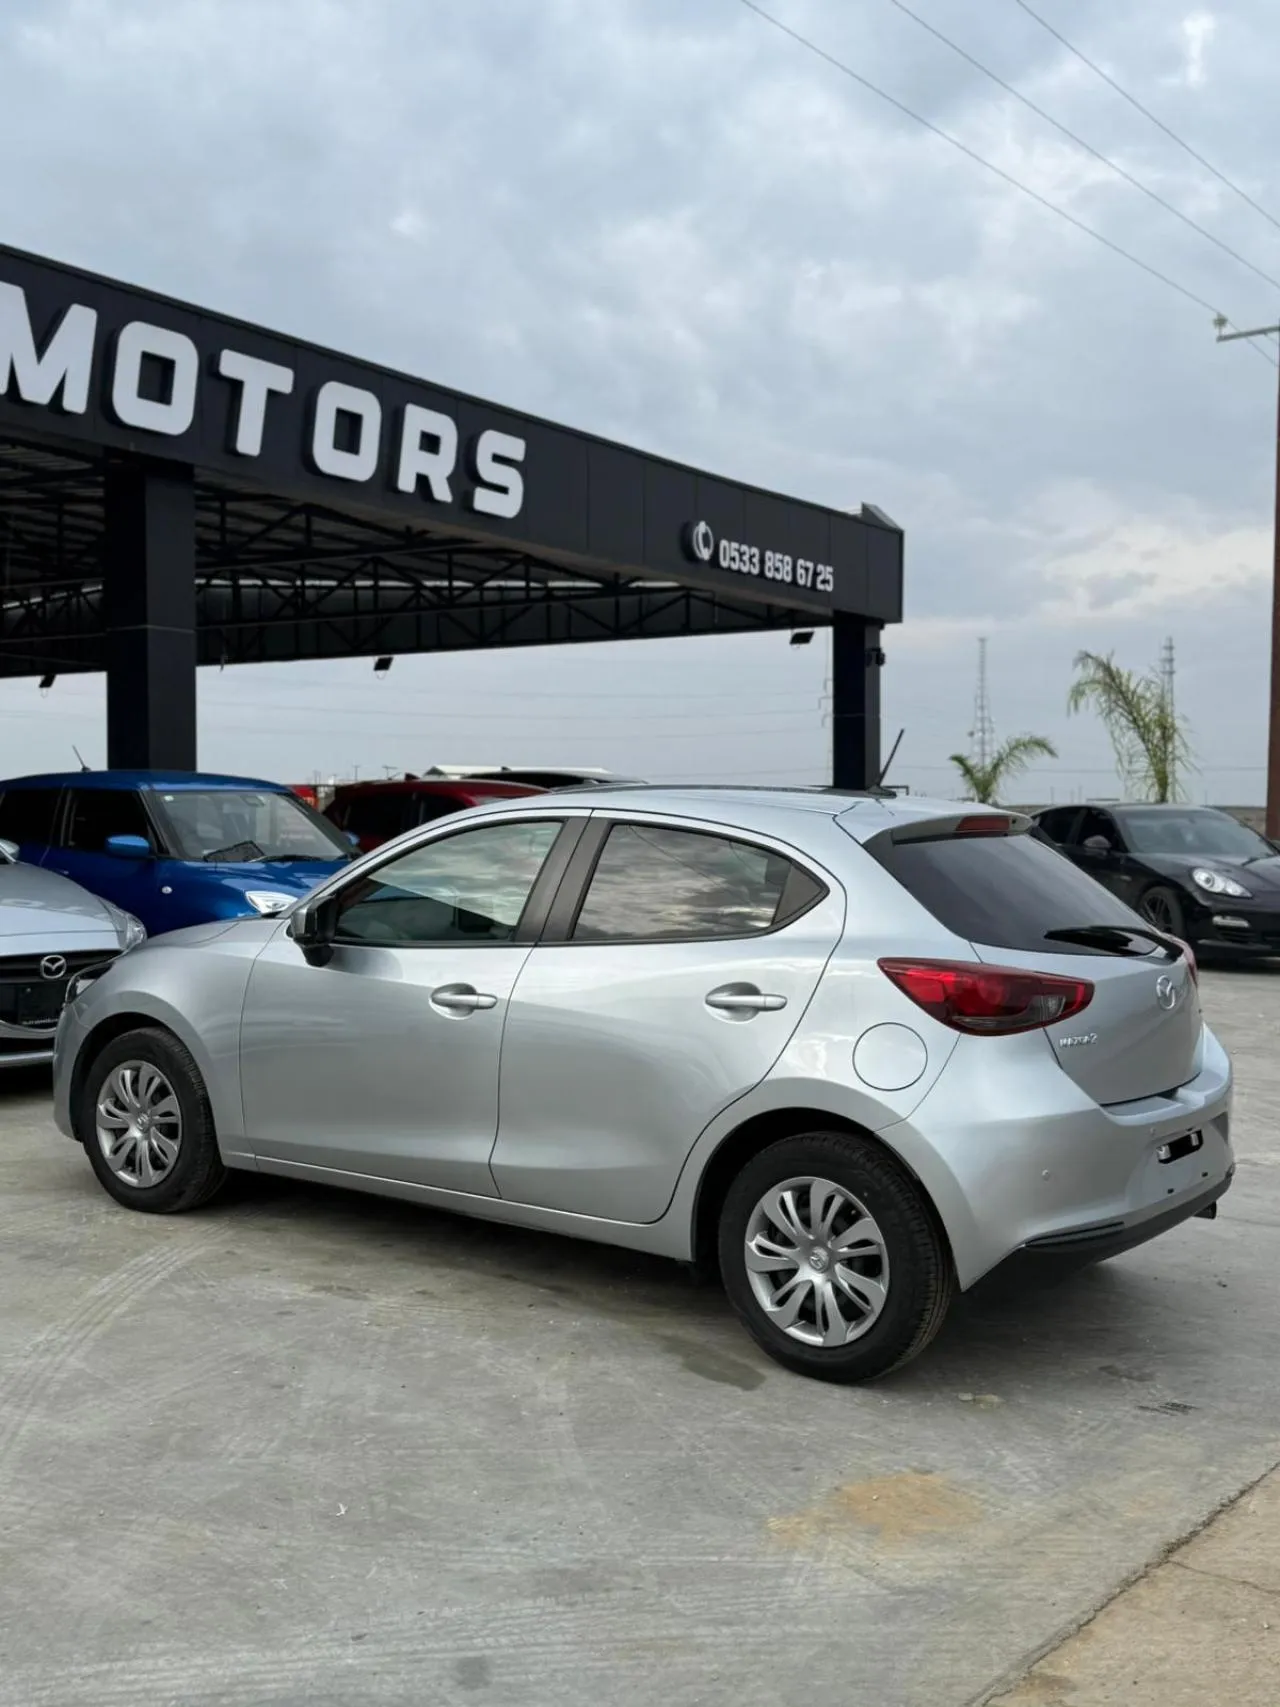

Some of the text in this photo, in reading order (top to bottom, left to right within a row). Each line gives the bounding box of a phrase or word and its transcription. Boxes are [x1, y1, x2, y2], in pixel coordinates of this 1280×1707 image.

[0, 281, 526, 518] MOTORS
[719, 539, 834, 592] 0533 858 67 25
